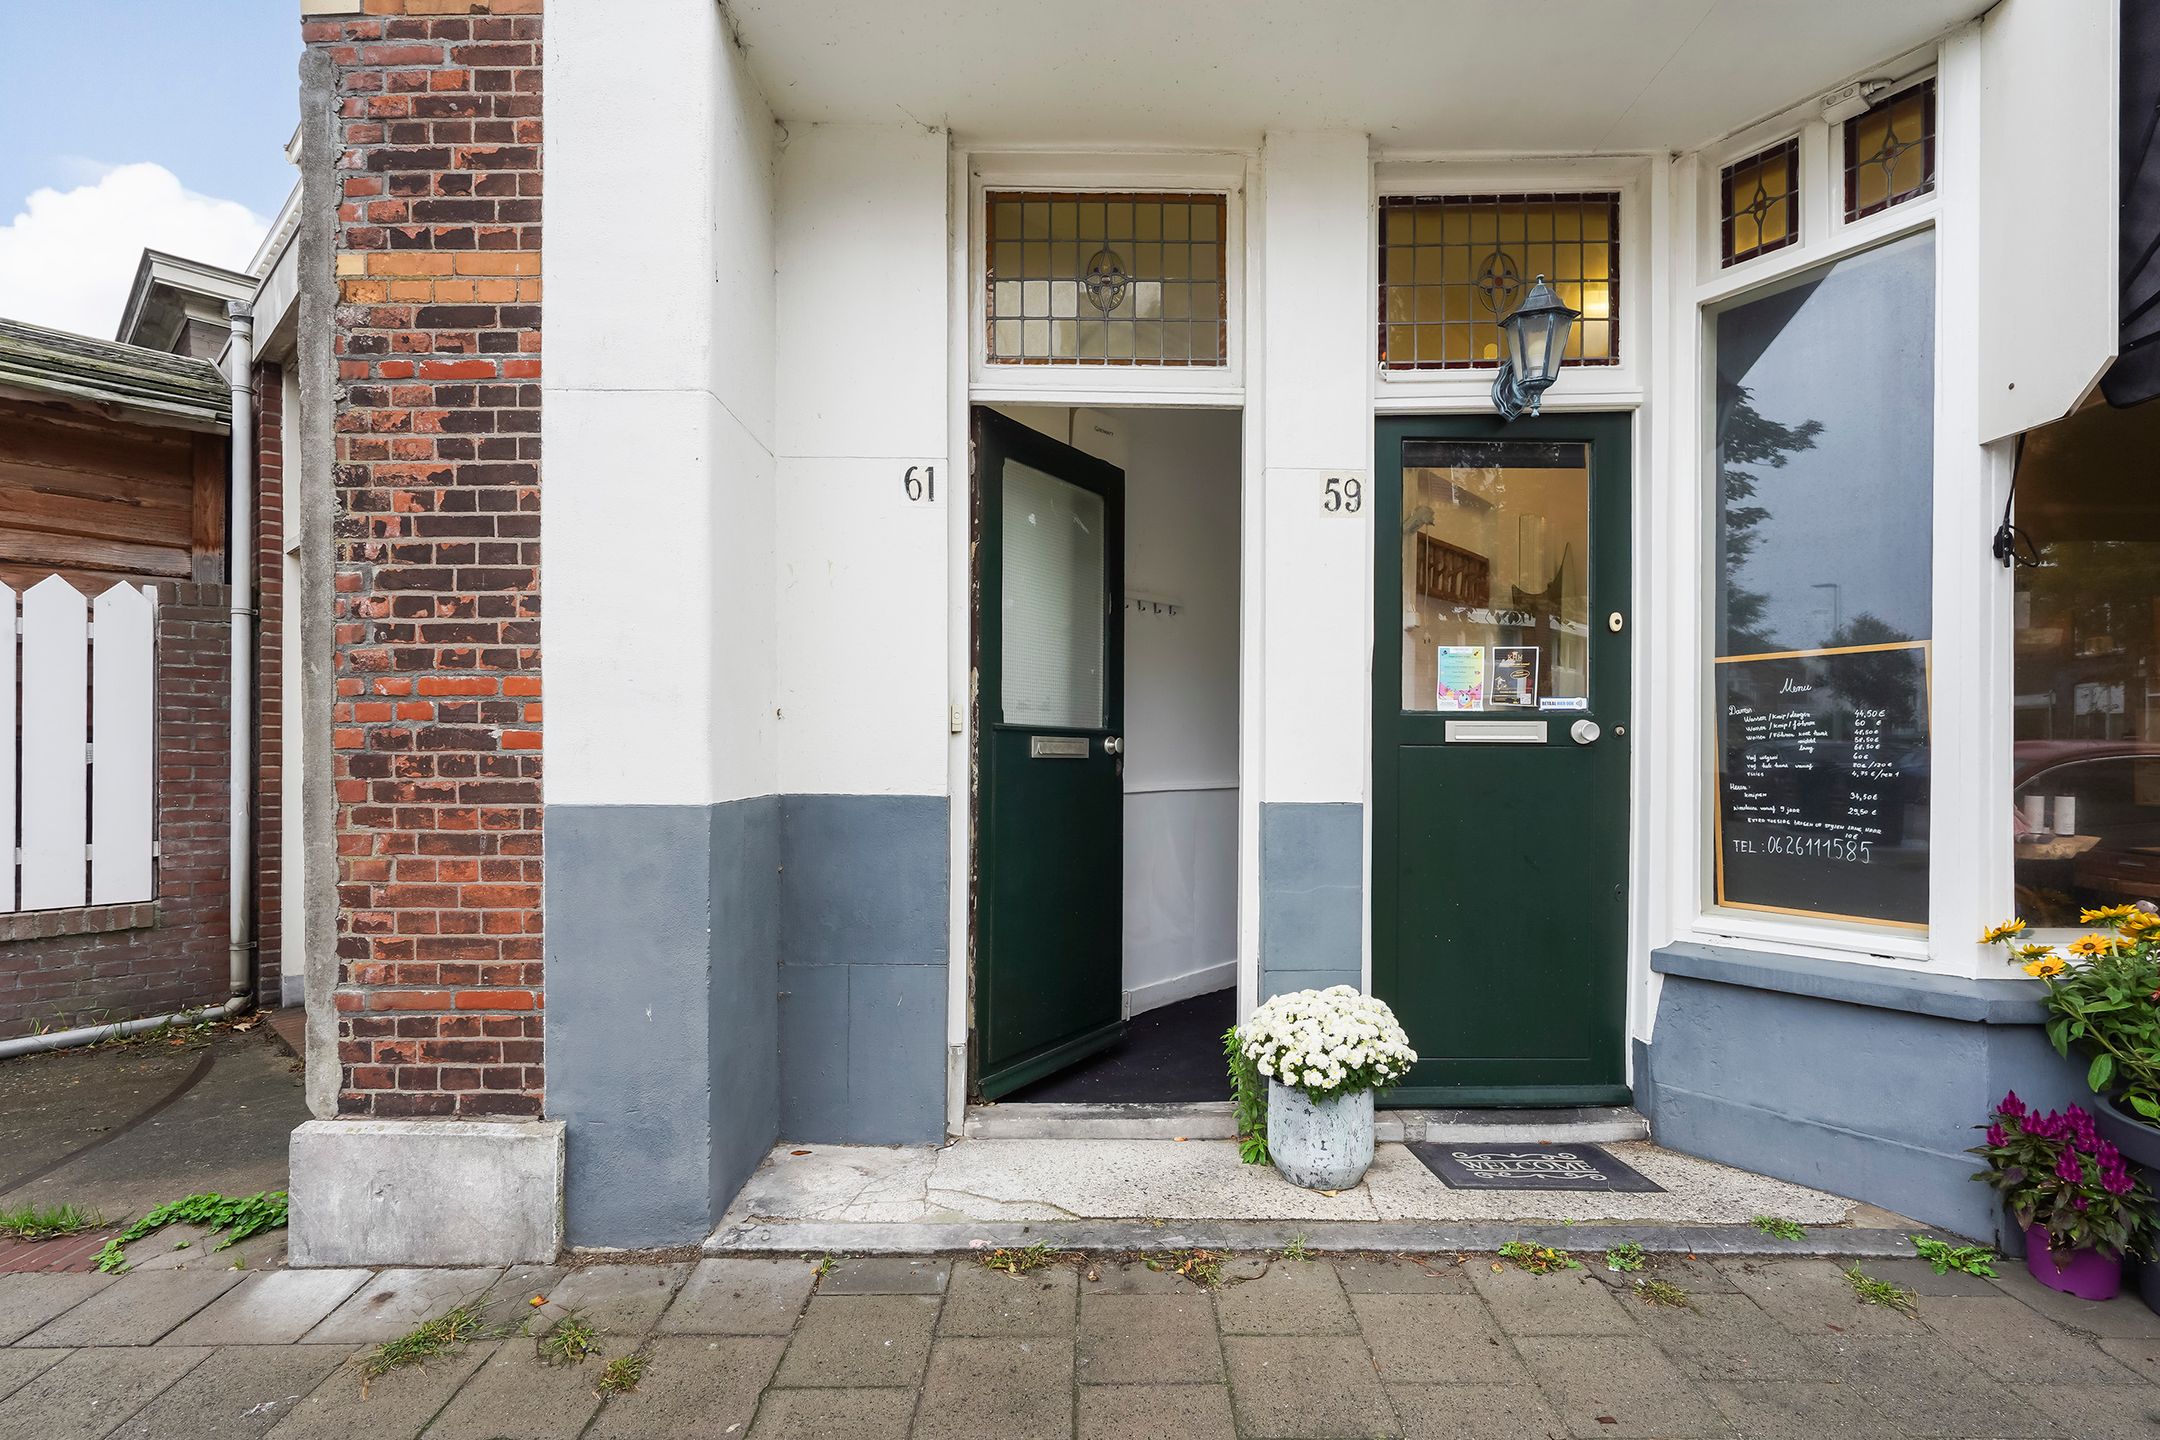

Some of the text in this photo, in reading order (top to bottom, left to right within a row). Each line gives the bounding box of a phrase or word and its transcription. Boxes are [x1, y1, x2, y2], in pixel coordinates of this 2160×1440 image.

[904, 466, 934, 502] 61
[1324, 478, 1361, 512] 59
[1779, 678, 1812, 694] Menu
[1854, 719, 1866, 727] 60
[1460, 1161, 1596, 1171] WELCOME
